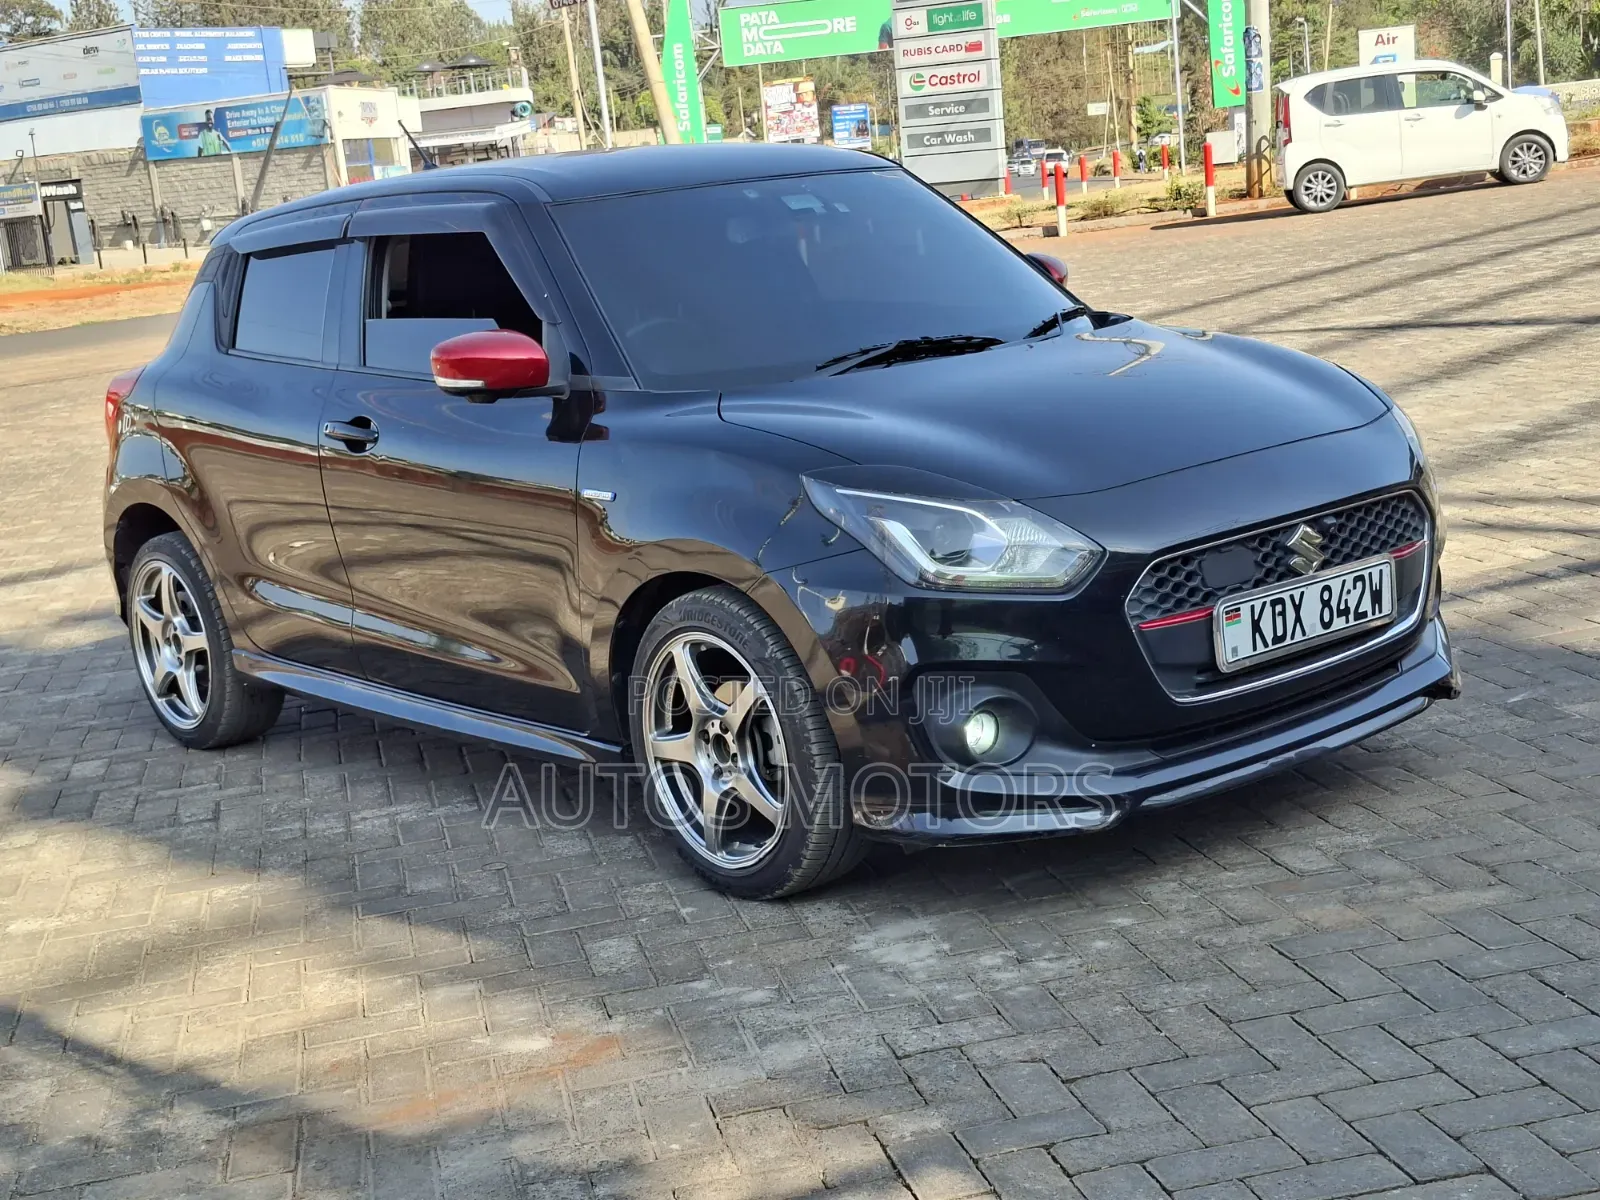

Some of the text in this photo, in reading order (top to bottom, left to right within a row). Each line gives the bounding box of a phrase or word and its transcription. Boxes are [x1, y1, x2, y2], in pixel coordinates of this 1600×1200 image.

[740, 10, 779, 26] PATA
[932, 12, 953, 26] light
[962, 9, 977, 21] life
[742, 16, 857, 42] MORE
[1219, 0, 1236, 77] Safarico
[1374, 32, 1399, 46] Air
[743, 41, 785, 57] DATA
[902, 43, 963, 57] RUBIS CARD
[928, 70, 980, 87] Castrol
[672, 43, 691, 132] Safaricom
[928, 103, 966, 116] Service
[923, 131, 975, 145] Car Wash
[1250, 568, 1384, 652] KDX 842W
